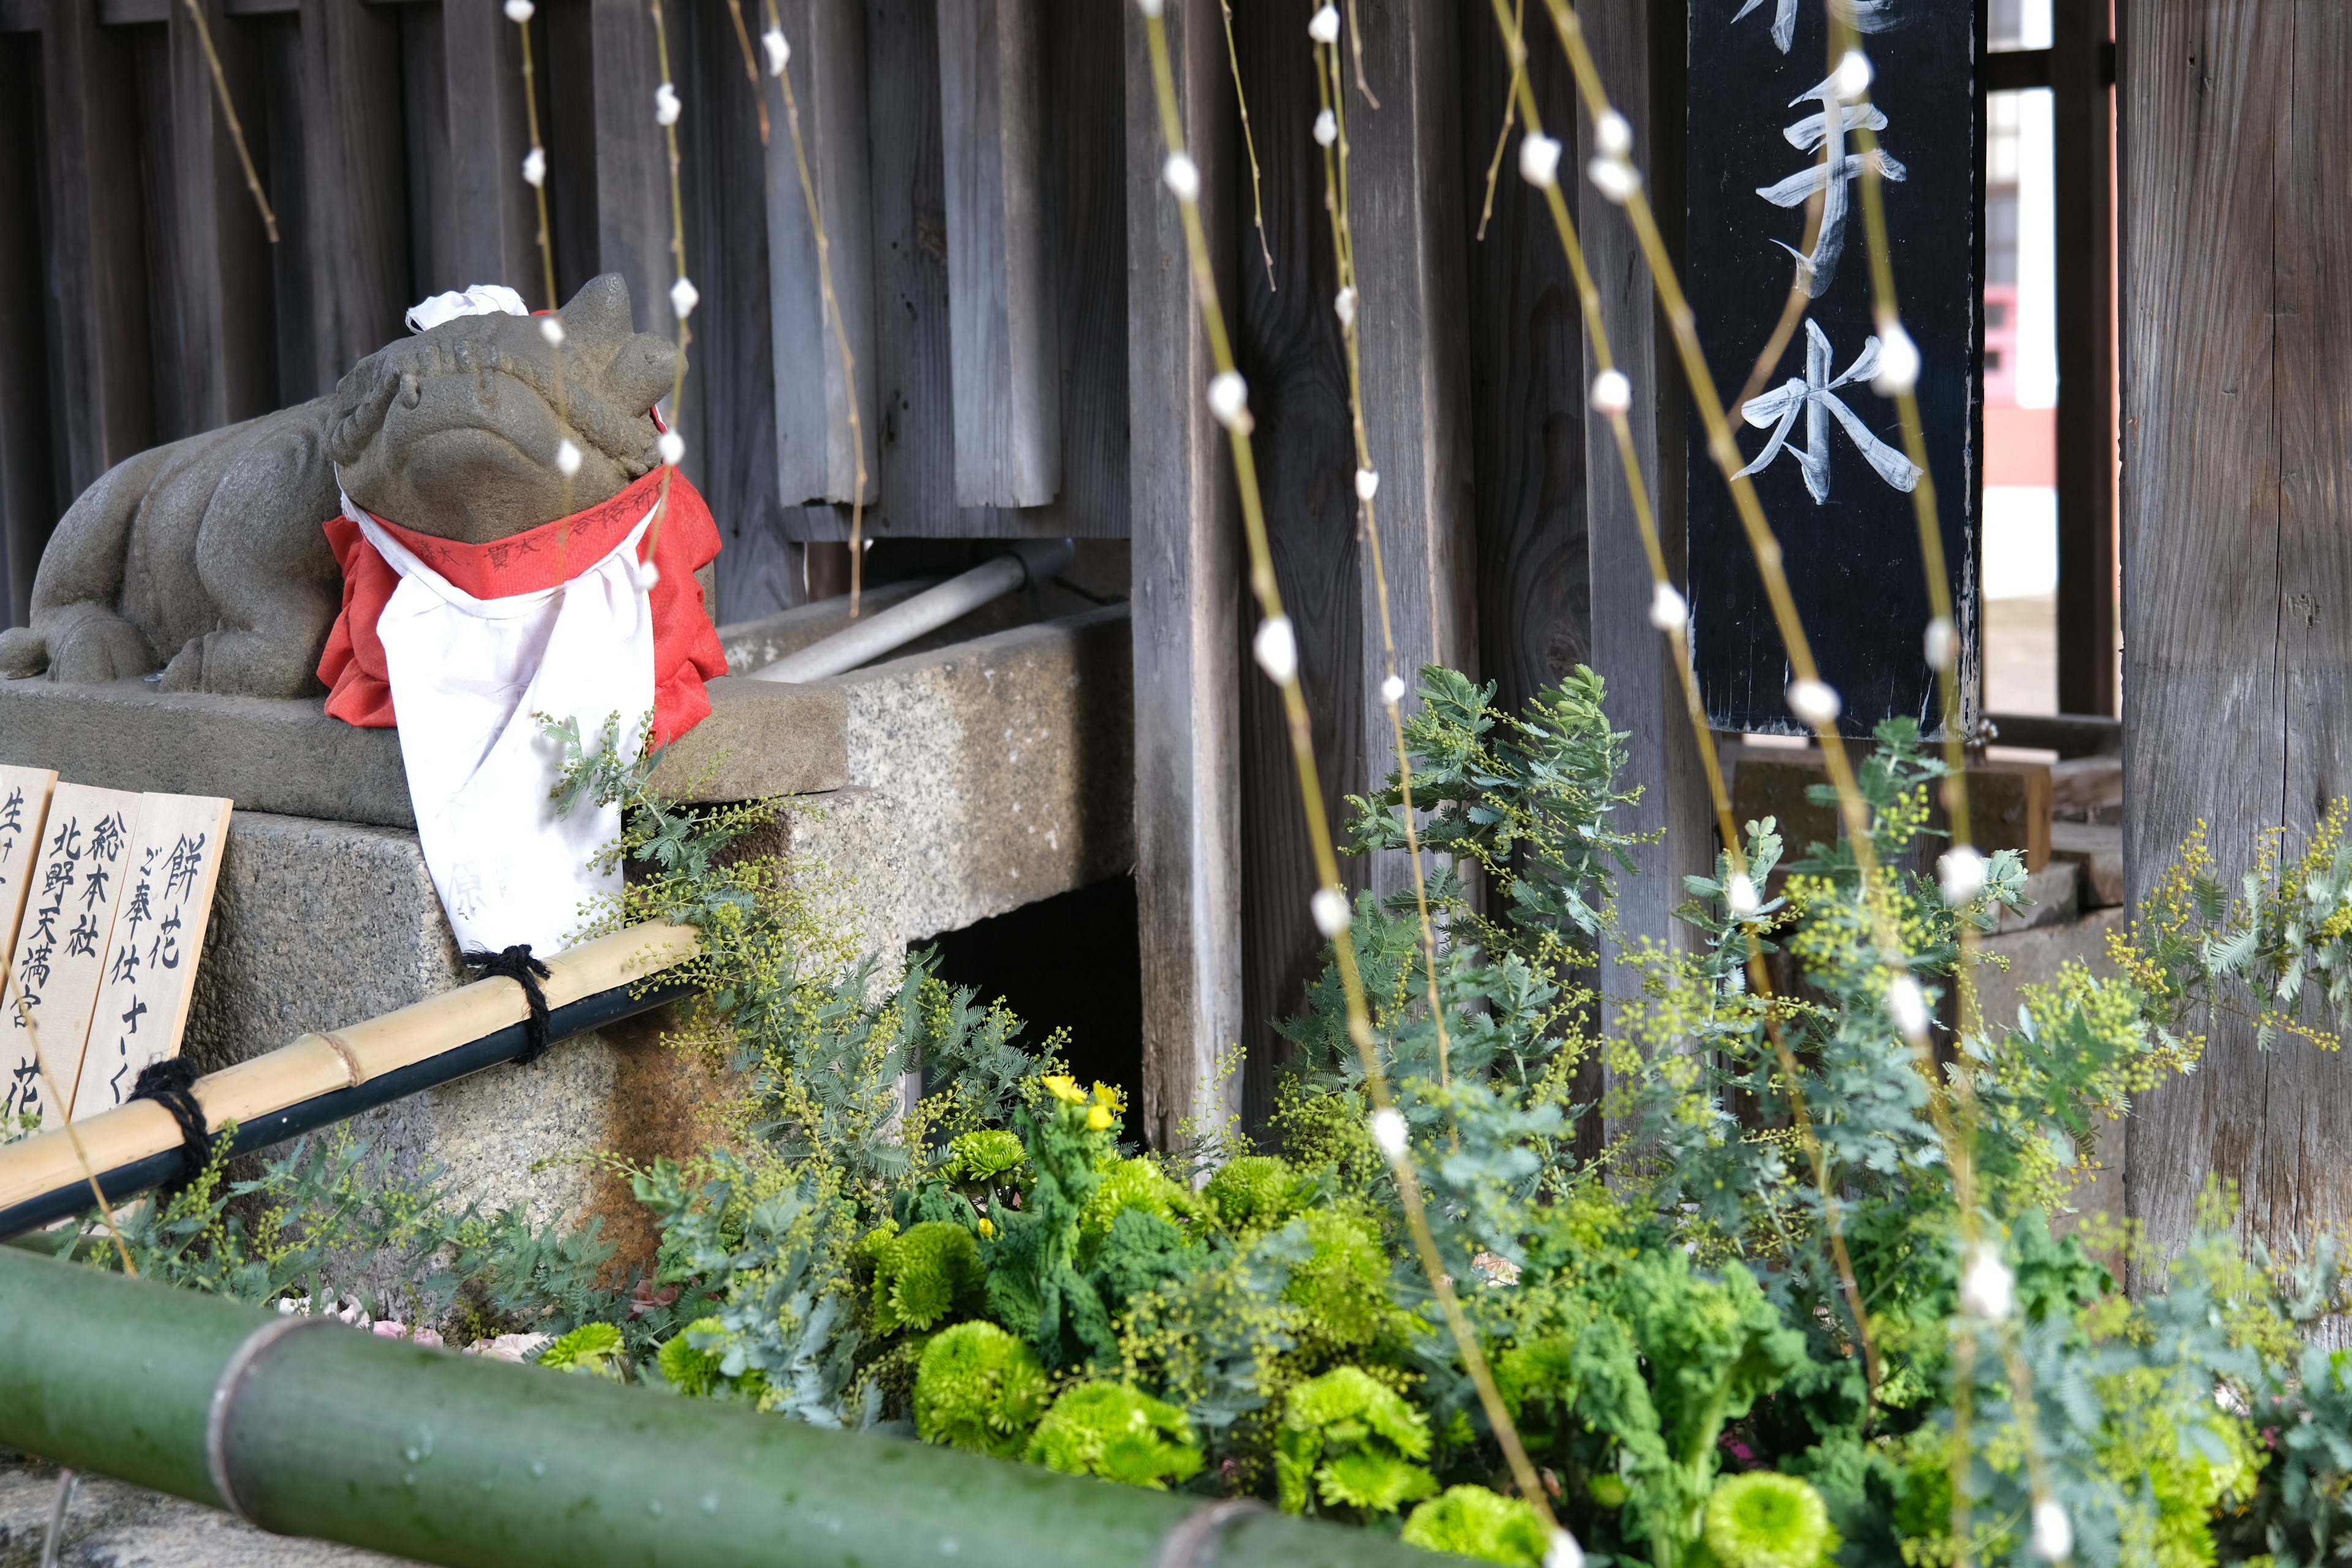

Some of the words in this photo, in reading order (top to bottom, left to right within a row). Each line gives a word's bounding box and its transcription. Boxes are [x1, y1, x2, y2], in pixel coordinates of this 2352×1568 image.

[1728, 0, 1924, 505] 手水
[64, 810, 126, 958] 総本社
[148, 831, 205, 970] 餅花
